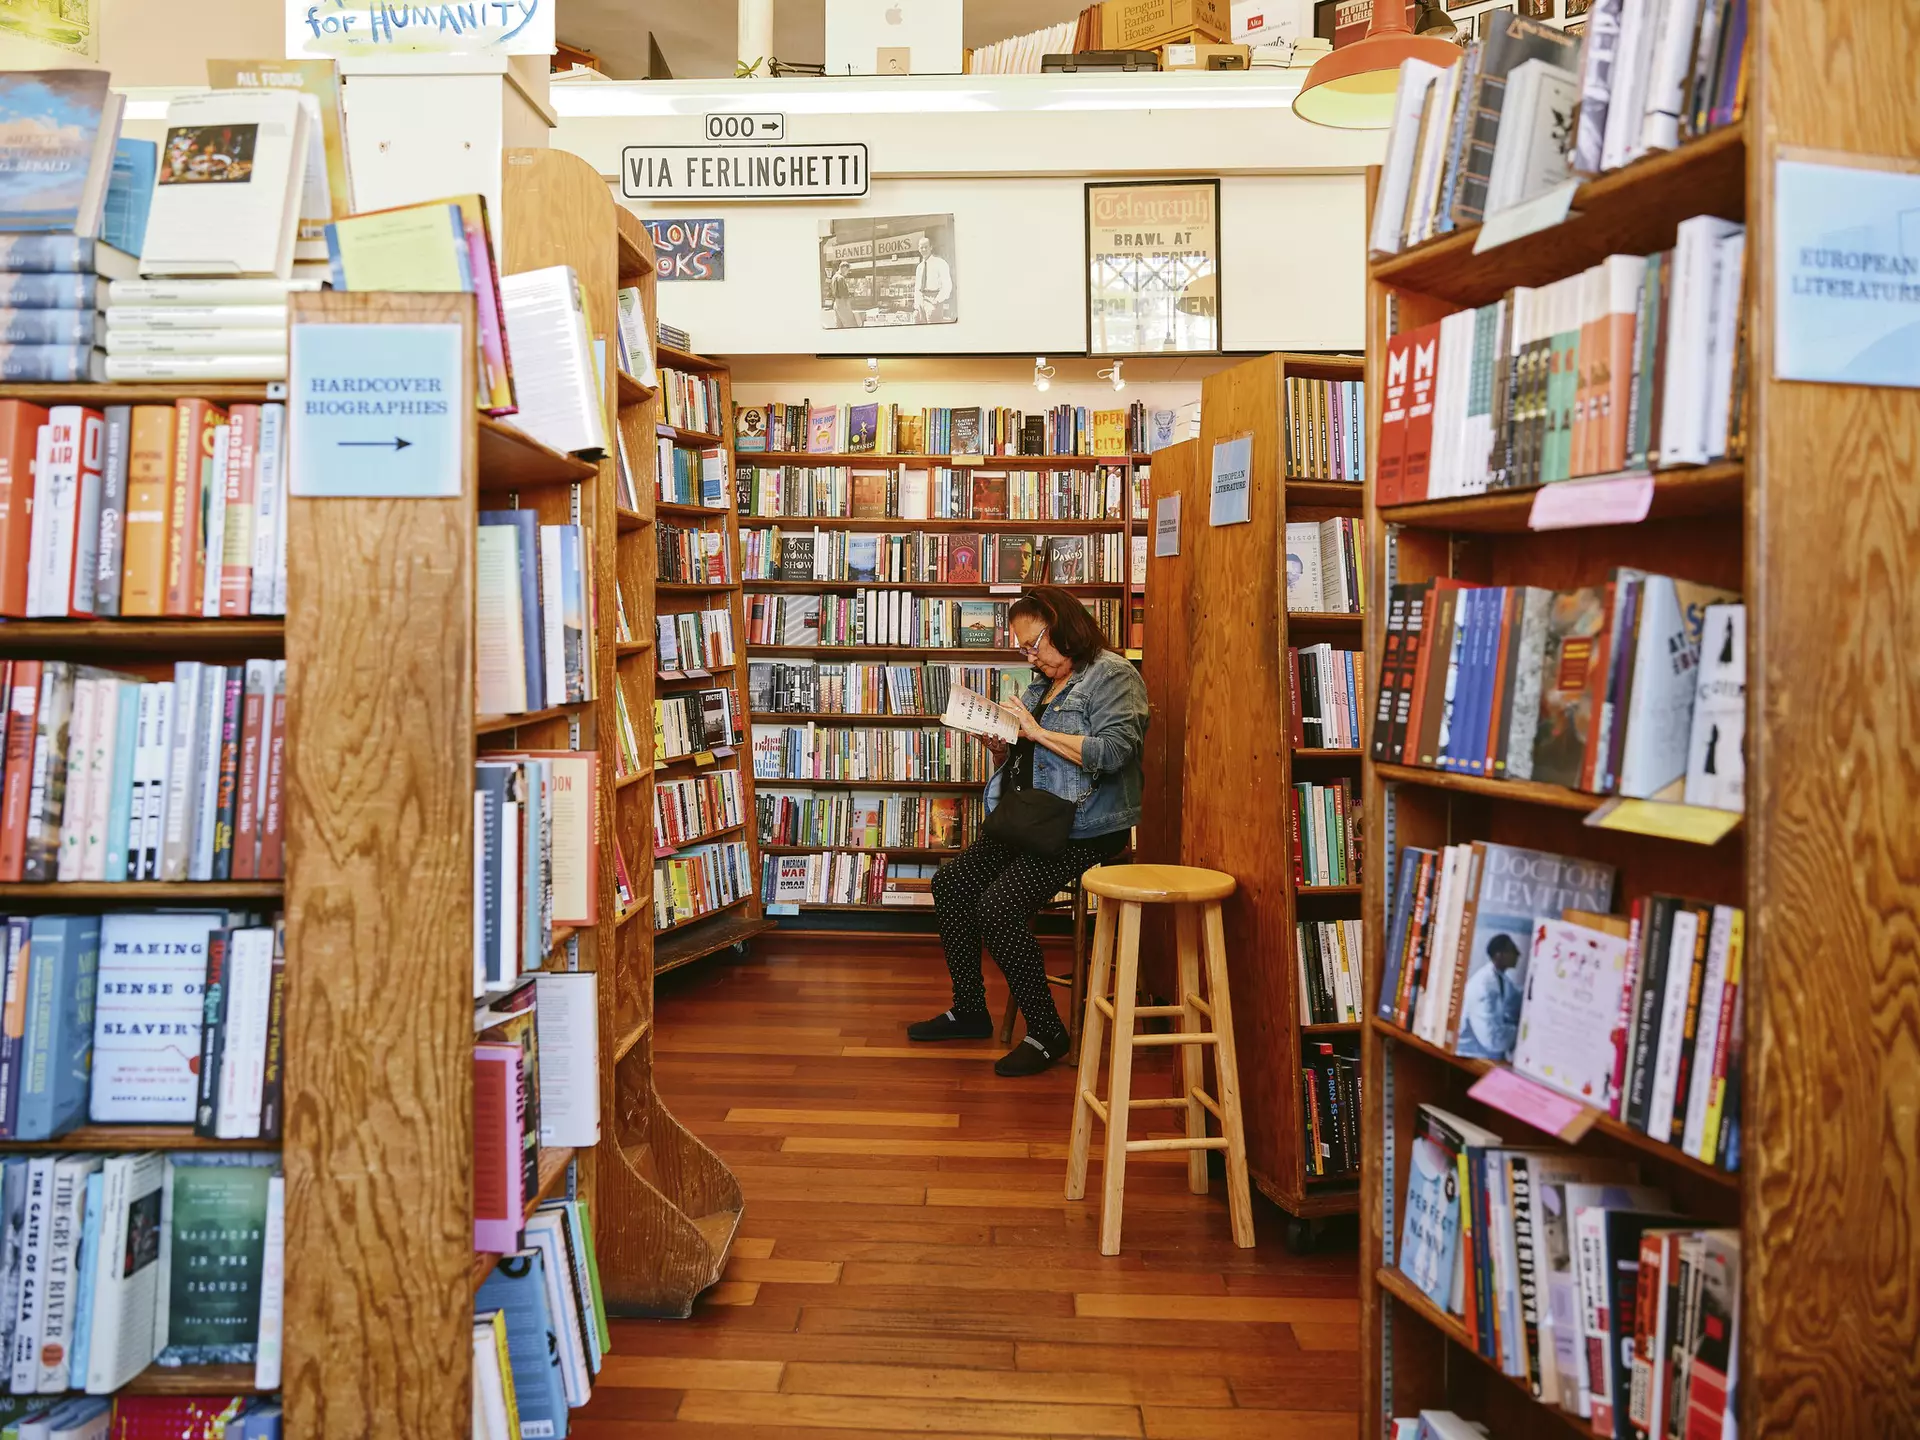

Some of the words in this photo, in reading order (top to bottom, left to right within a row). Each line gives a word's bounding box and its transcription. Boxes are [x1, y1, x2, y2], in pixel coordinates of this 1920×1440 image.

[370, 0, 538, 43] HUMANITY
[1124, 9, 1165, 29] Random
[1125, 24, 1155, 41] House
[630, 157, 673, 187] VIA
[686, 154, 858, 188] FERLINGHETTI
[1097, 190, 1209, 224] Telegraph
[652, 221, 721, 252] LOVE
[1114, 233, 1165, 247] BRAWL
[1174, 232, 1192, 245] AT
[835, 244, 873, 259] BANNED
[878, 238, 912, 254] BOOKS
[1800, 247, 1919, 275] EUROPEAN
[311, 378, 442, 393] HARDCOVER
[305, 400, 448, 415] BIOGRAPHIES
[812, 416, 824, 425] THE
[1095, 412, 1123, 425] OPEN
[53, 425, 71, 443] ON
[1095, 438, 1123, 449] CITY
[177, 406, 190, 483] AMERICAN
[50, 446, 73, 464] AIR
[228, 414, 243, 499] CROSSING
[1217, 469, 1246, 483] EUROPEAN
[1215, 481, 1246, 494] LITERATURE
[173, 485, 186, 529] OASIS
[783, 552, 814, 560] WOMAN
[788, 542, 810, 551] ONE
[784, 561, 813, 569] SHOW
[221, 742, 237, 772] Sell
[218, 775, 234, 809] Out
[781, 868, 806, 877] WAR
[782, 859, 806, 868] AMERICAN
[1489, 848, 1609, 892] DOCTOR
[113, 943, 203, 955] MAKING
[103, 983, 173, 994] SENSE
[33, 1171, 44, 1197] THE
[56, 1174, 74, 1213] THE
[1410, 1190, 1453, 1235] PERFECT
[28, 1205, 41, 1248] GATES
[51, 1216, 71, 1276] GREAT
[1513, 1169, 1538, 1327] SOLZHENITSYN
[26, 1254, 36, 1273] OF
[219, 1255, 249, 1266] THE
[21, 1277, 34, 1323] GAZA
[45, 1281, 65, 1337] RIVER
